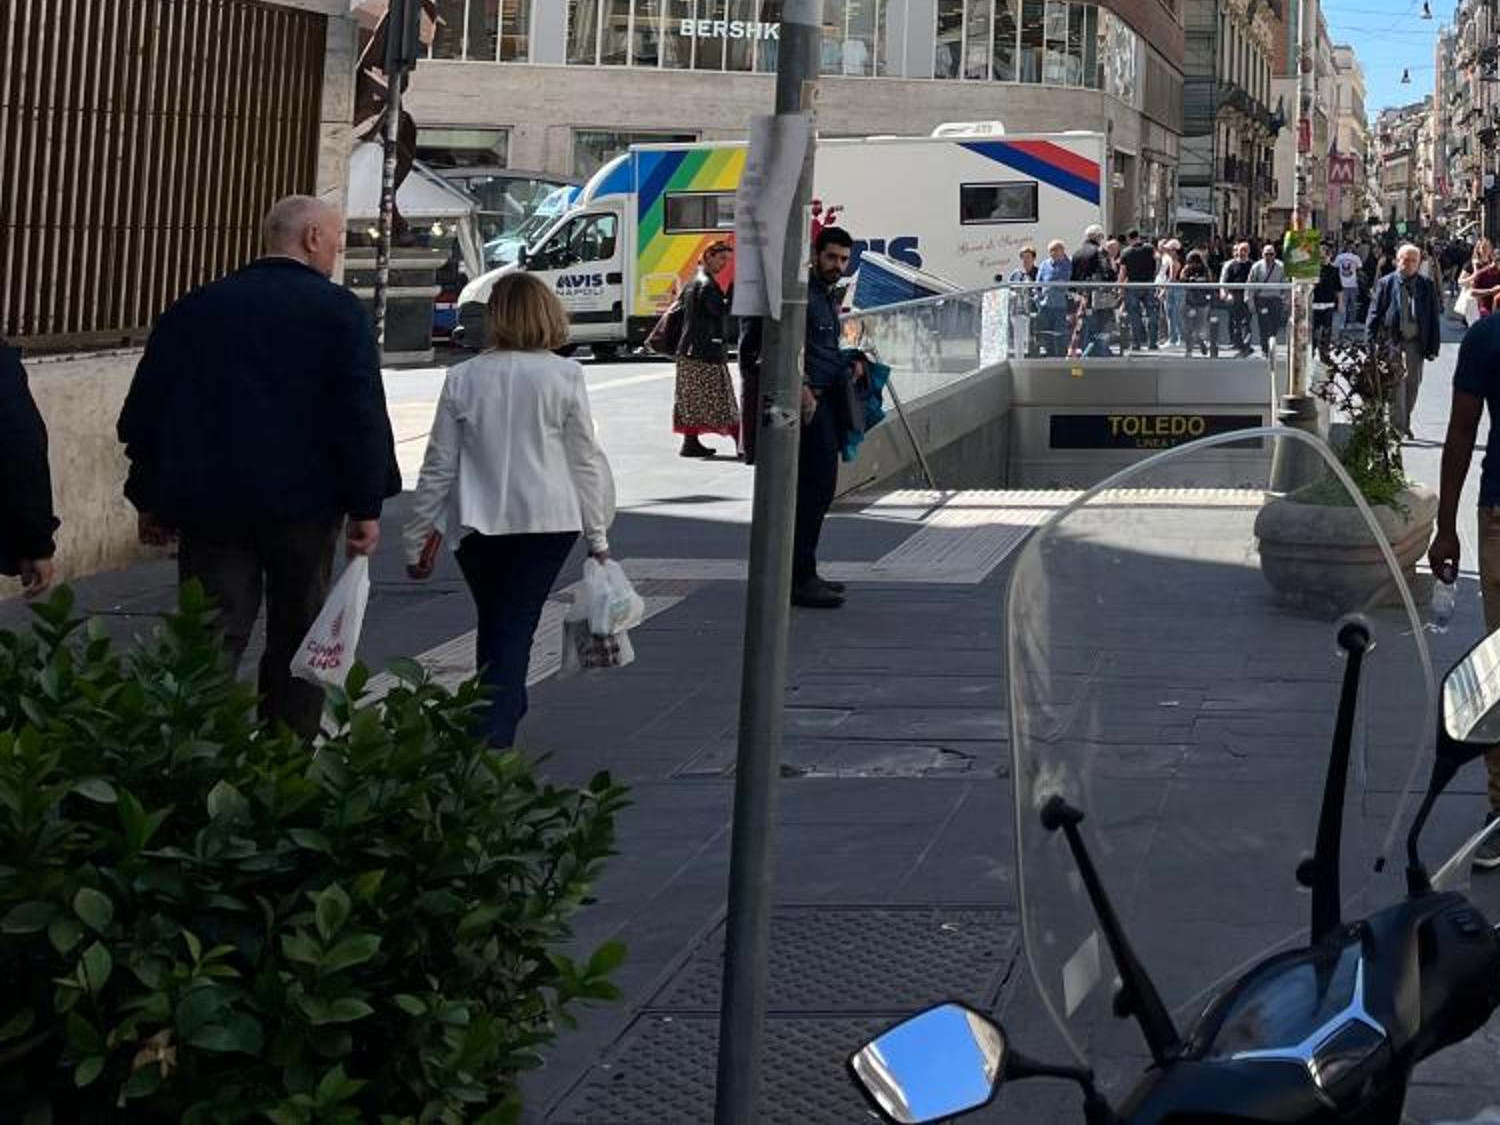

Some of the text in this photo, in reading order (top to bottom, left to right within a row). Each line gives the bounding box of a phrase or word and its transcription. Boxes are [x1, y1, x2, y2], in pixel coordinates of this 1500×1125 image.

[680, 18, 781, 40] BERSHK
[1330, 162, 1353, 183] M
[556, 274, 604, 288] AVIS
[1108, 416, 1205, 436] TOLEDO
